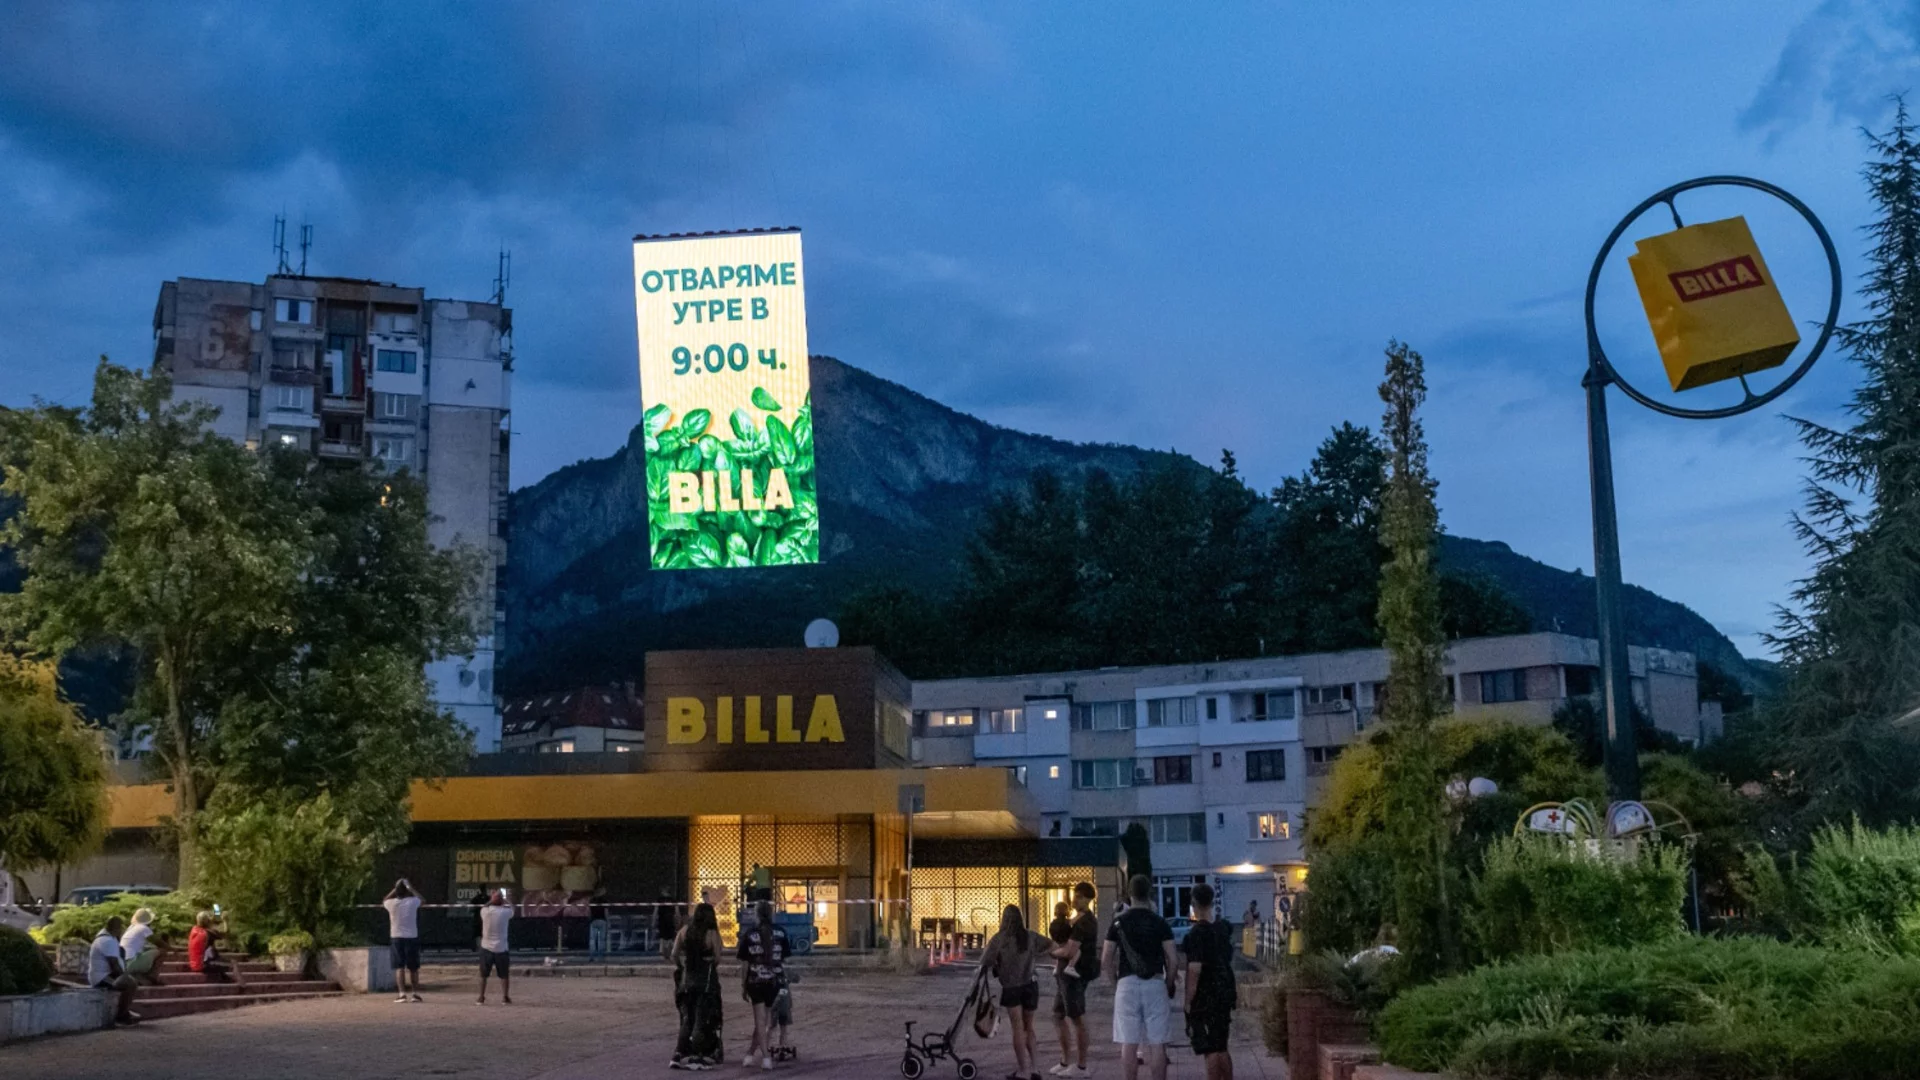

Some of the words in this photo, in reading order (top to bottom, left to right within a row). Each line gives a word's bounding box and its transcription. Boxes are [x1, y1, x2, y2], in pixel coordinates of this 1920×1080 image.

[642, 262, 796, 292] ОТВАРЯМЕ
[1677, 263, 1757, 296] BILLA
[673, 298, 743, 325] УТРЕ
[751, 297, 769, 320] В
[672, 343, 749, 376] 9:00
[669, 468, 794, 513] BILLA
[667, 694, 845, 744] BILLA
[456, 864, 515, 883] BILLA
